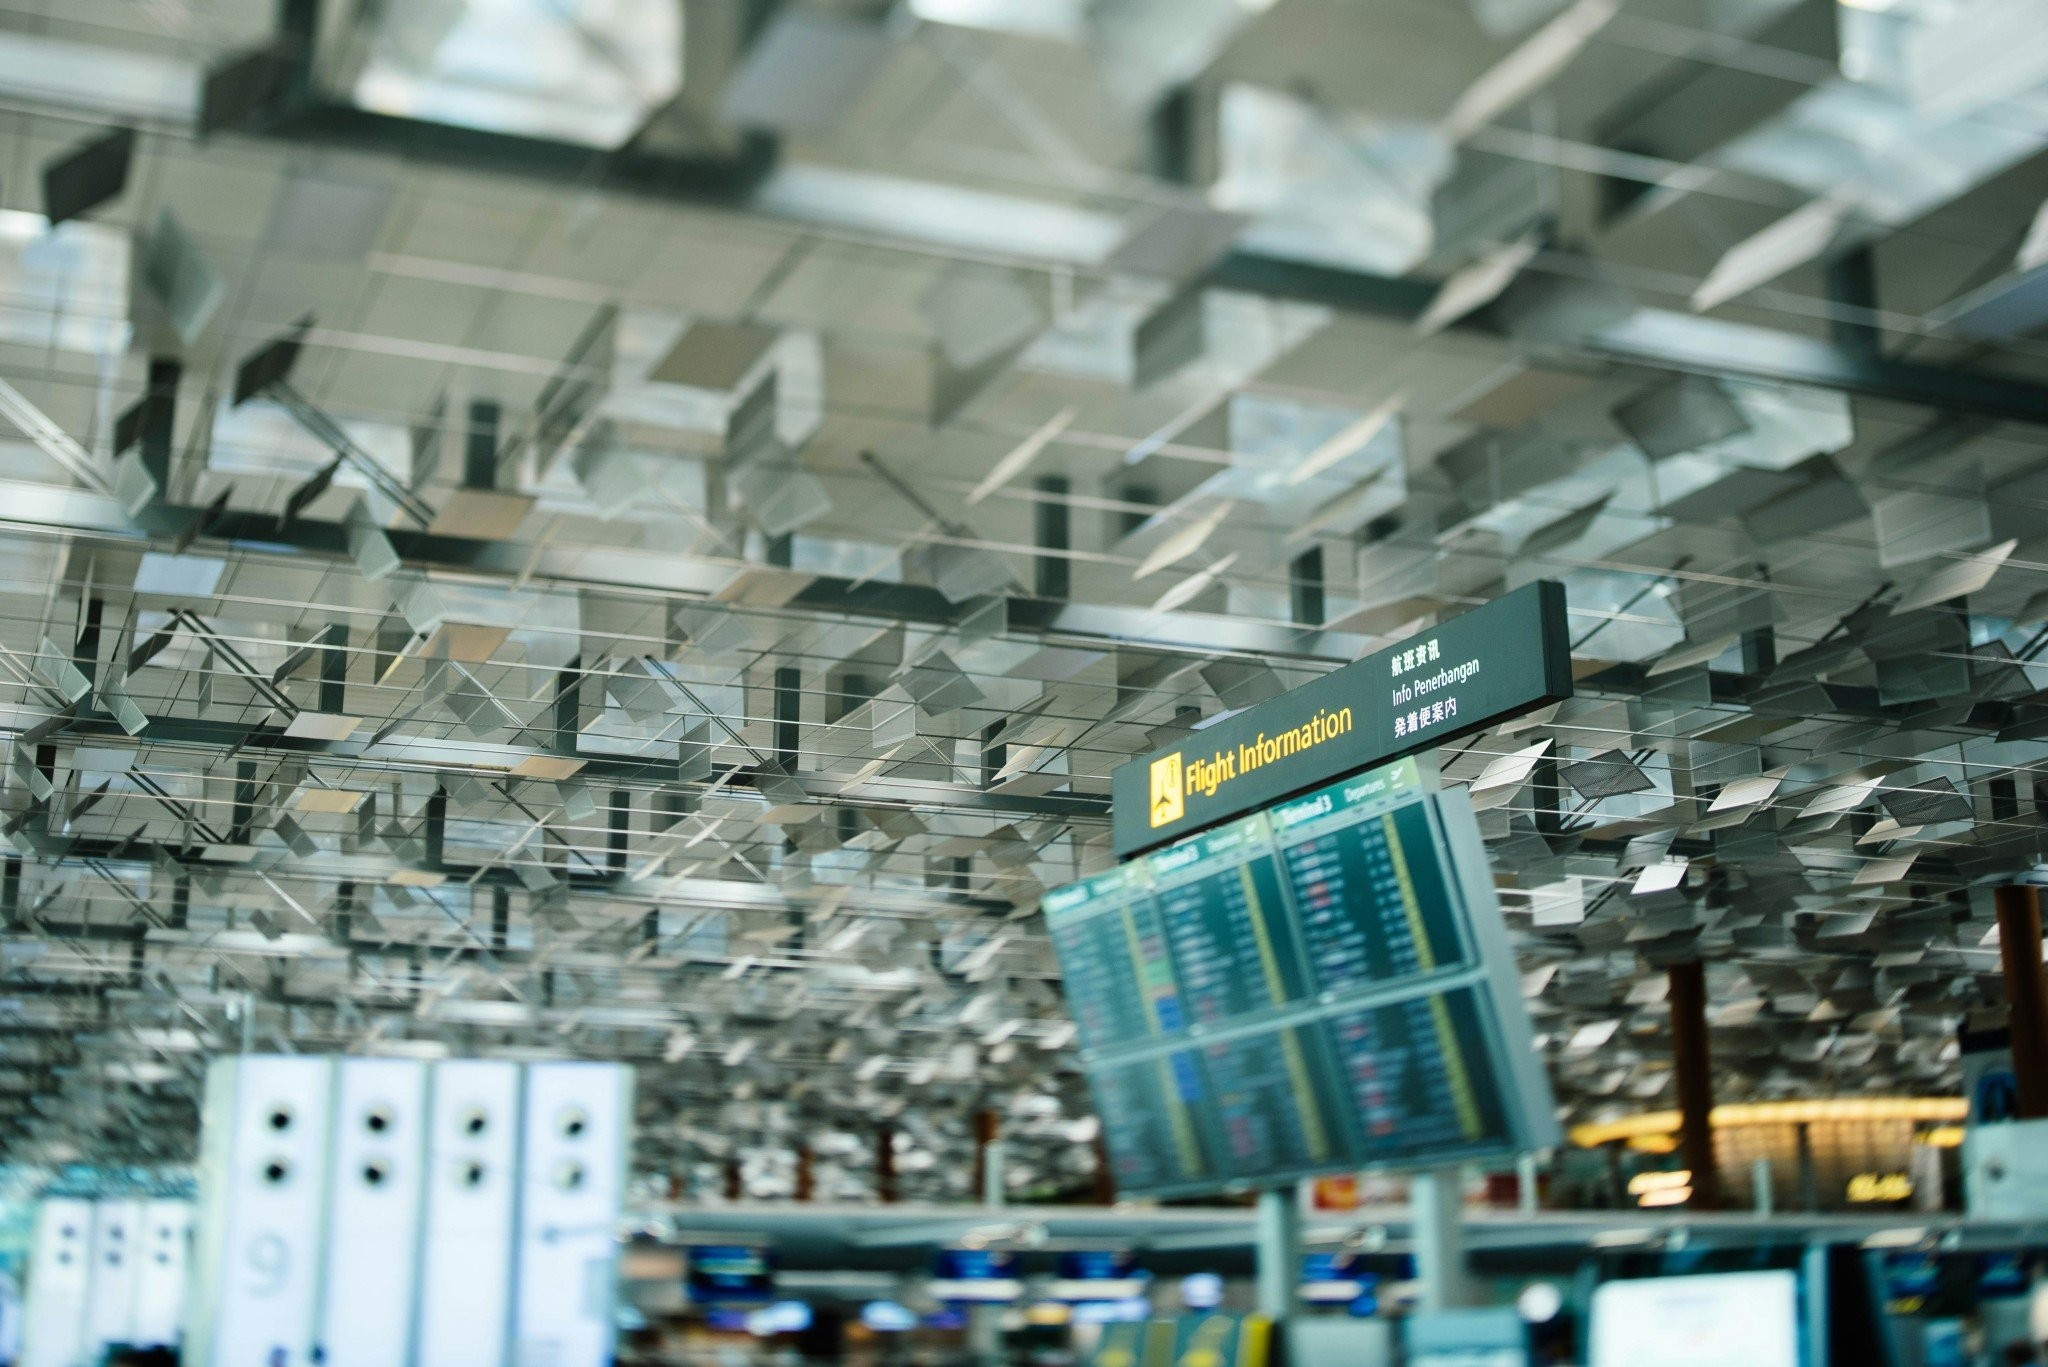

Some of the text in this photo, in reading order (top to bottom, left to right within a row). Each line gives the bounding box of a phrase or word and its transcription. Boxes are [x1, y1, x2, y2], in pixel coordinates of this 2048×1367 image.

[1392, 659, 1479, 707] Info Penerbangan
[1394, 696, 1457, 738] 発着便案内
[1185, 707, 1352, 797] Flight Information
